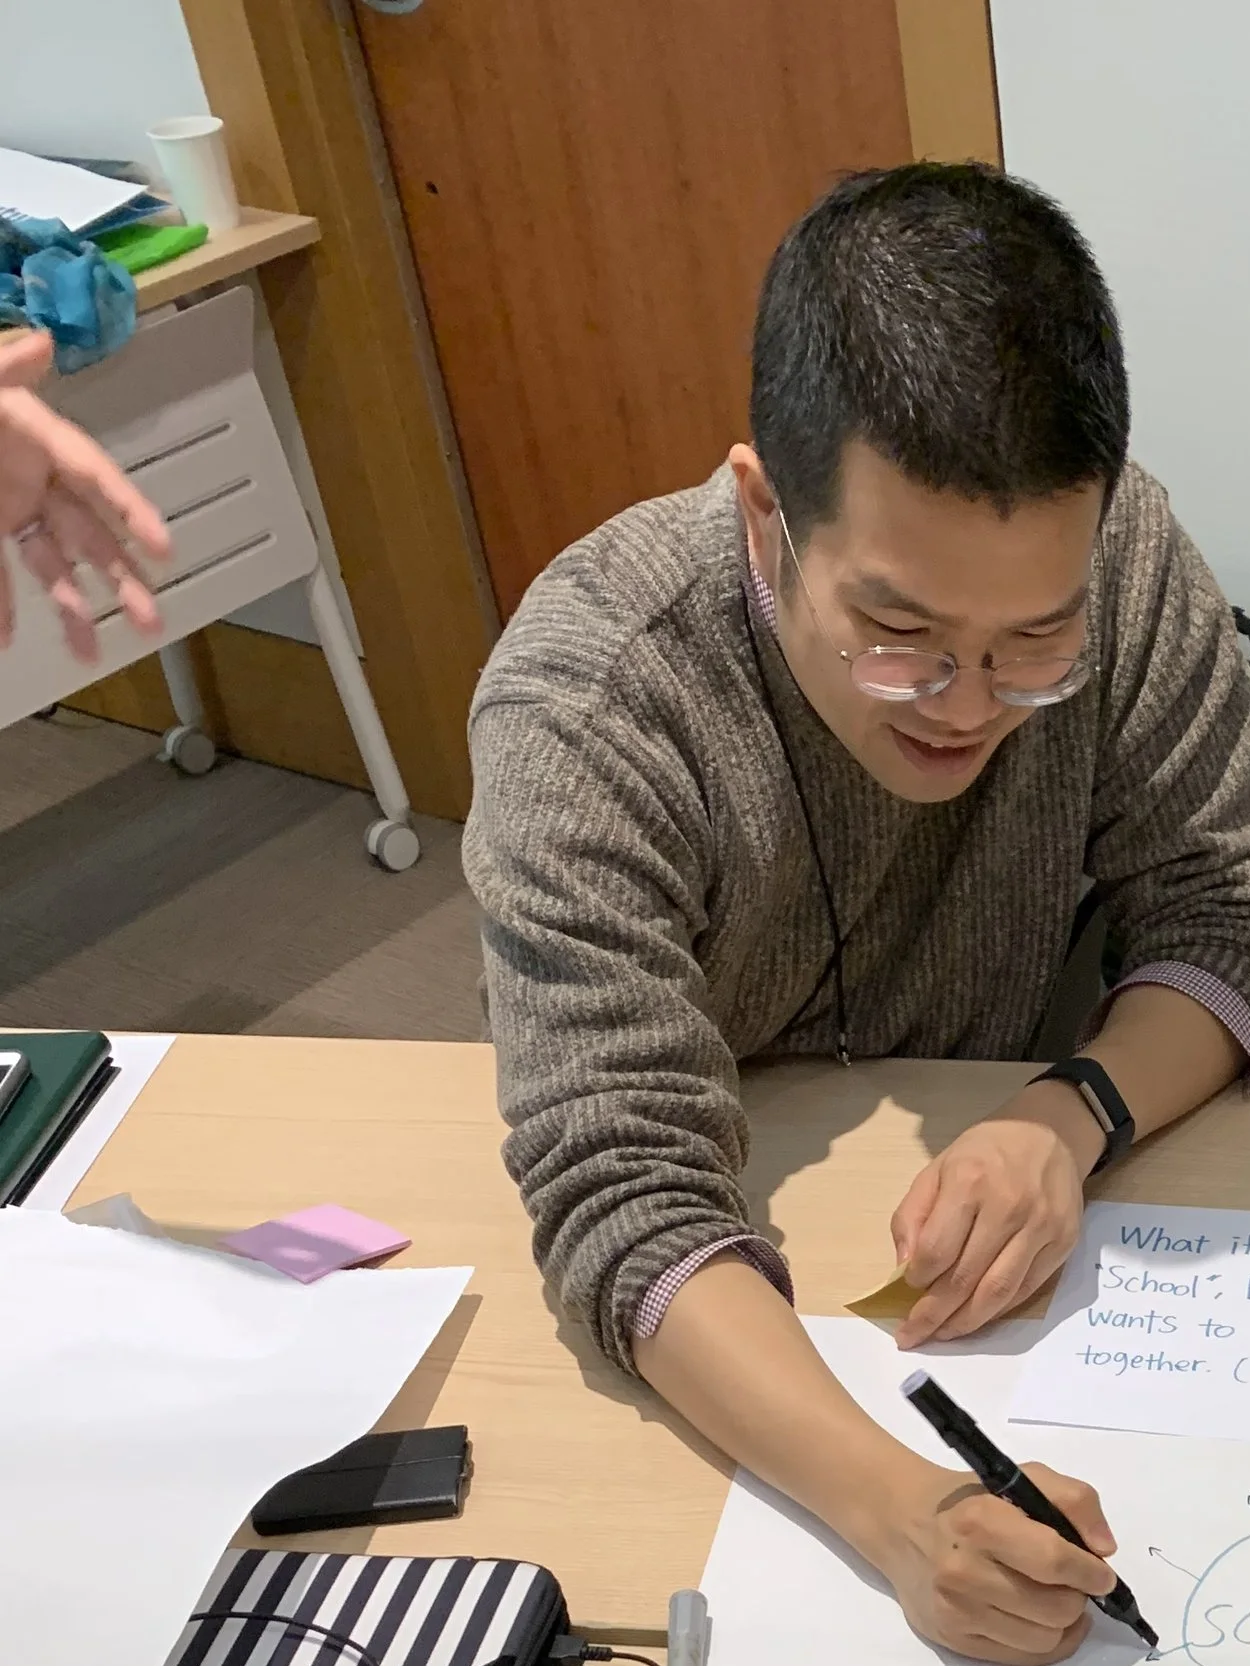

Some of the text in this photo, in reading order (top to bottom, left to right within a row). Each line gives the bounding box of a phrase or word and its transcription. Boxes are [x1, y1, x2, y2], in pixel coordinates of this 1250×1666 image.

[1120, 1225, 1211, 1254] What
[1197, 1317, 1236, 1339] to
[1075, 1343, 1211, 1377] together.
